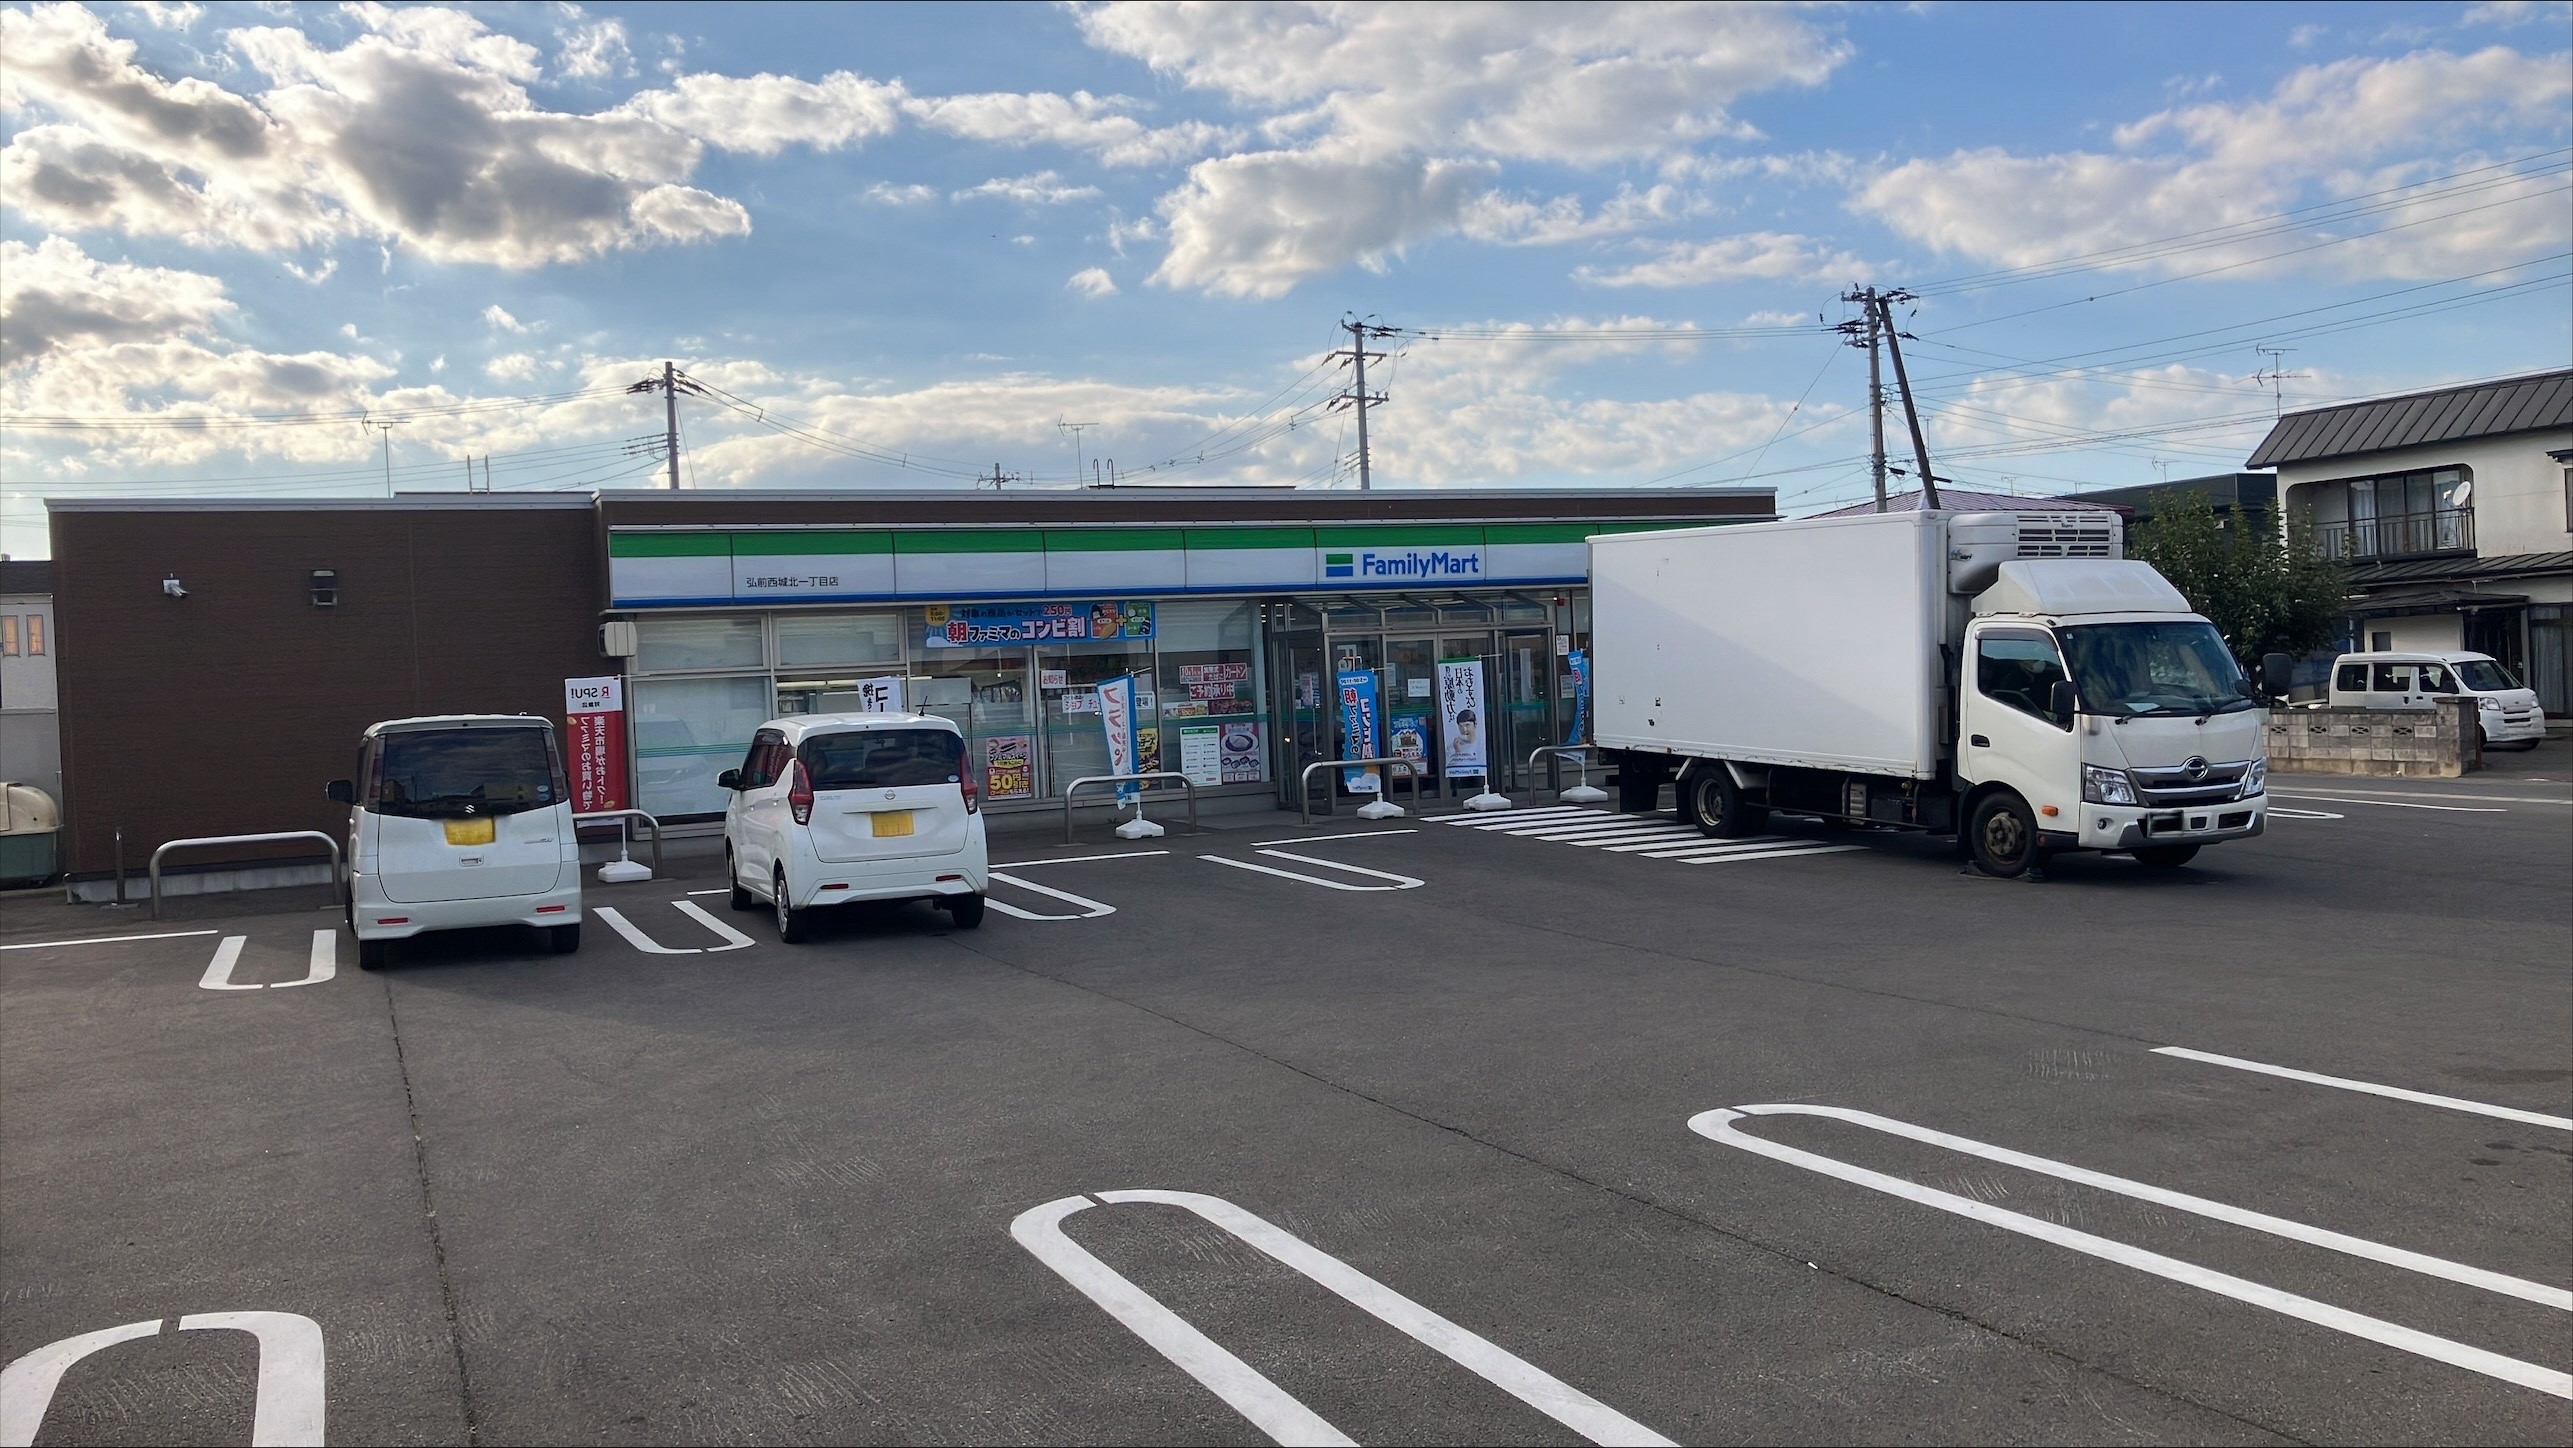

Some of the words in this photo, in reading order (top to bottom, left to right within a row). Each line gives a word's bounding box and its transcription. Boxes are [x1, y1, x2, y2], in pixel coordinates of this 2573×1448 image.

[1362, 552, 1479, 578] FamilyMart
[746, 576, 839, 588] 弘前西城北一丁目店
[946, 617, 1087, 643] 朝ファミマのコンビ割
[1225, 664, 1247, 679] カートン
